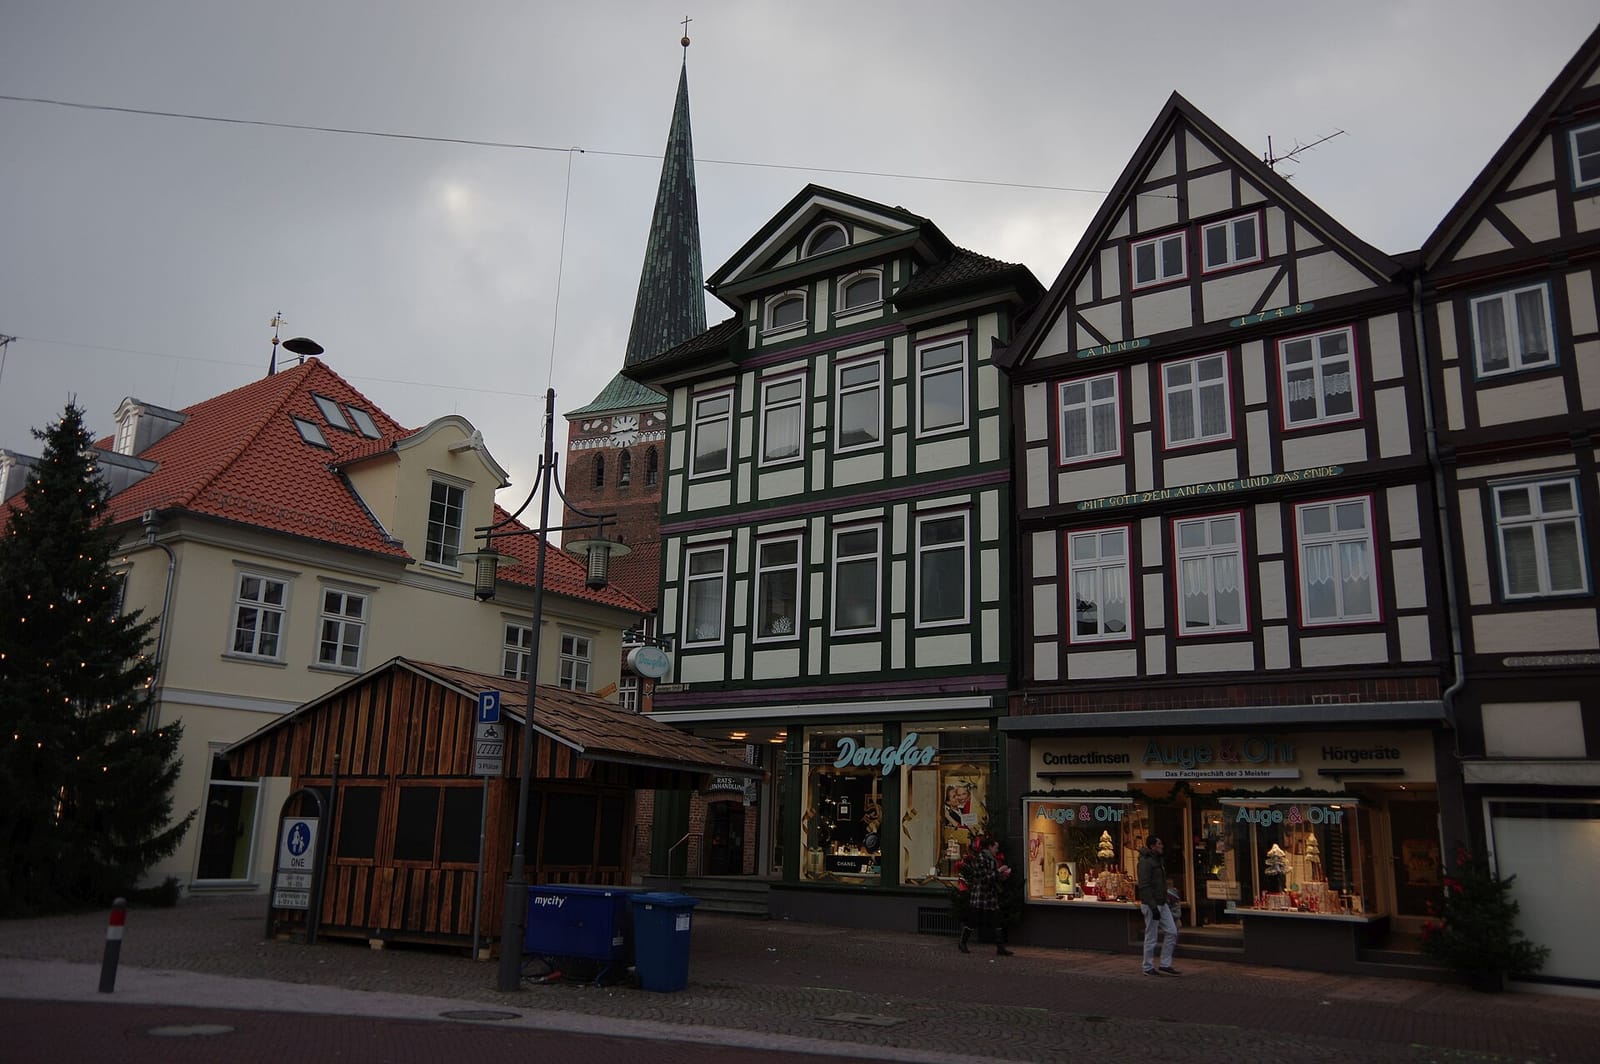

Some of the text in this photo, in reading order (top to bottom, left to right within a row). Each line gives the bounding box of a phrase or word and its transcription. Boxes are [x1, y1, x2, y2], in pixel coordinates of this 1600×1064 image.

[1240, 304, 1302, 326] 1748
[1087, 340, 1140, 357] ANNO
[1082, 465, 1338, 511] MIT GOTT DEN ANFANG UND DAS ENDE
[482, 695, 495, 719] P
[833, 732, 936, 776] Douglas
[1042, 751, 1130, 765] Contactlinsen
[1143, 736, 1294, 769] Auge & Ohr
[1322, 746, 1400, 762] Hörgeräte
[1179, 770, 1224, 778] Fachgeschäft
[1036, 804, 1125, 824] Auge & Ohr
[1235, 806, 1344, 827] Auge & Ohr
[534, 896, 565, 908] mycity
